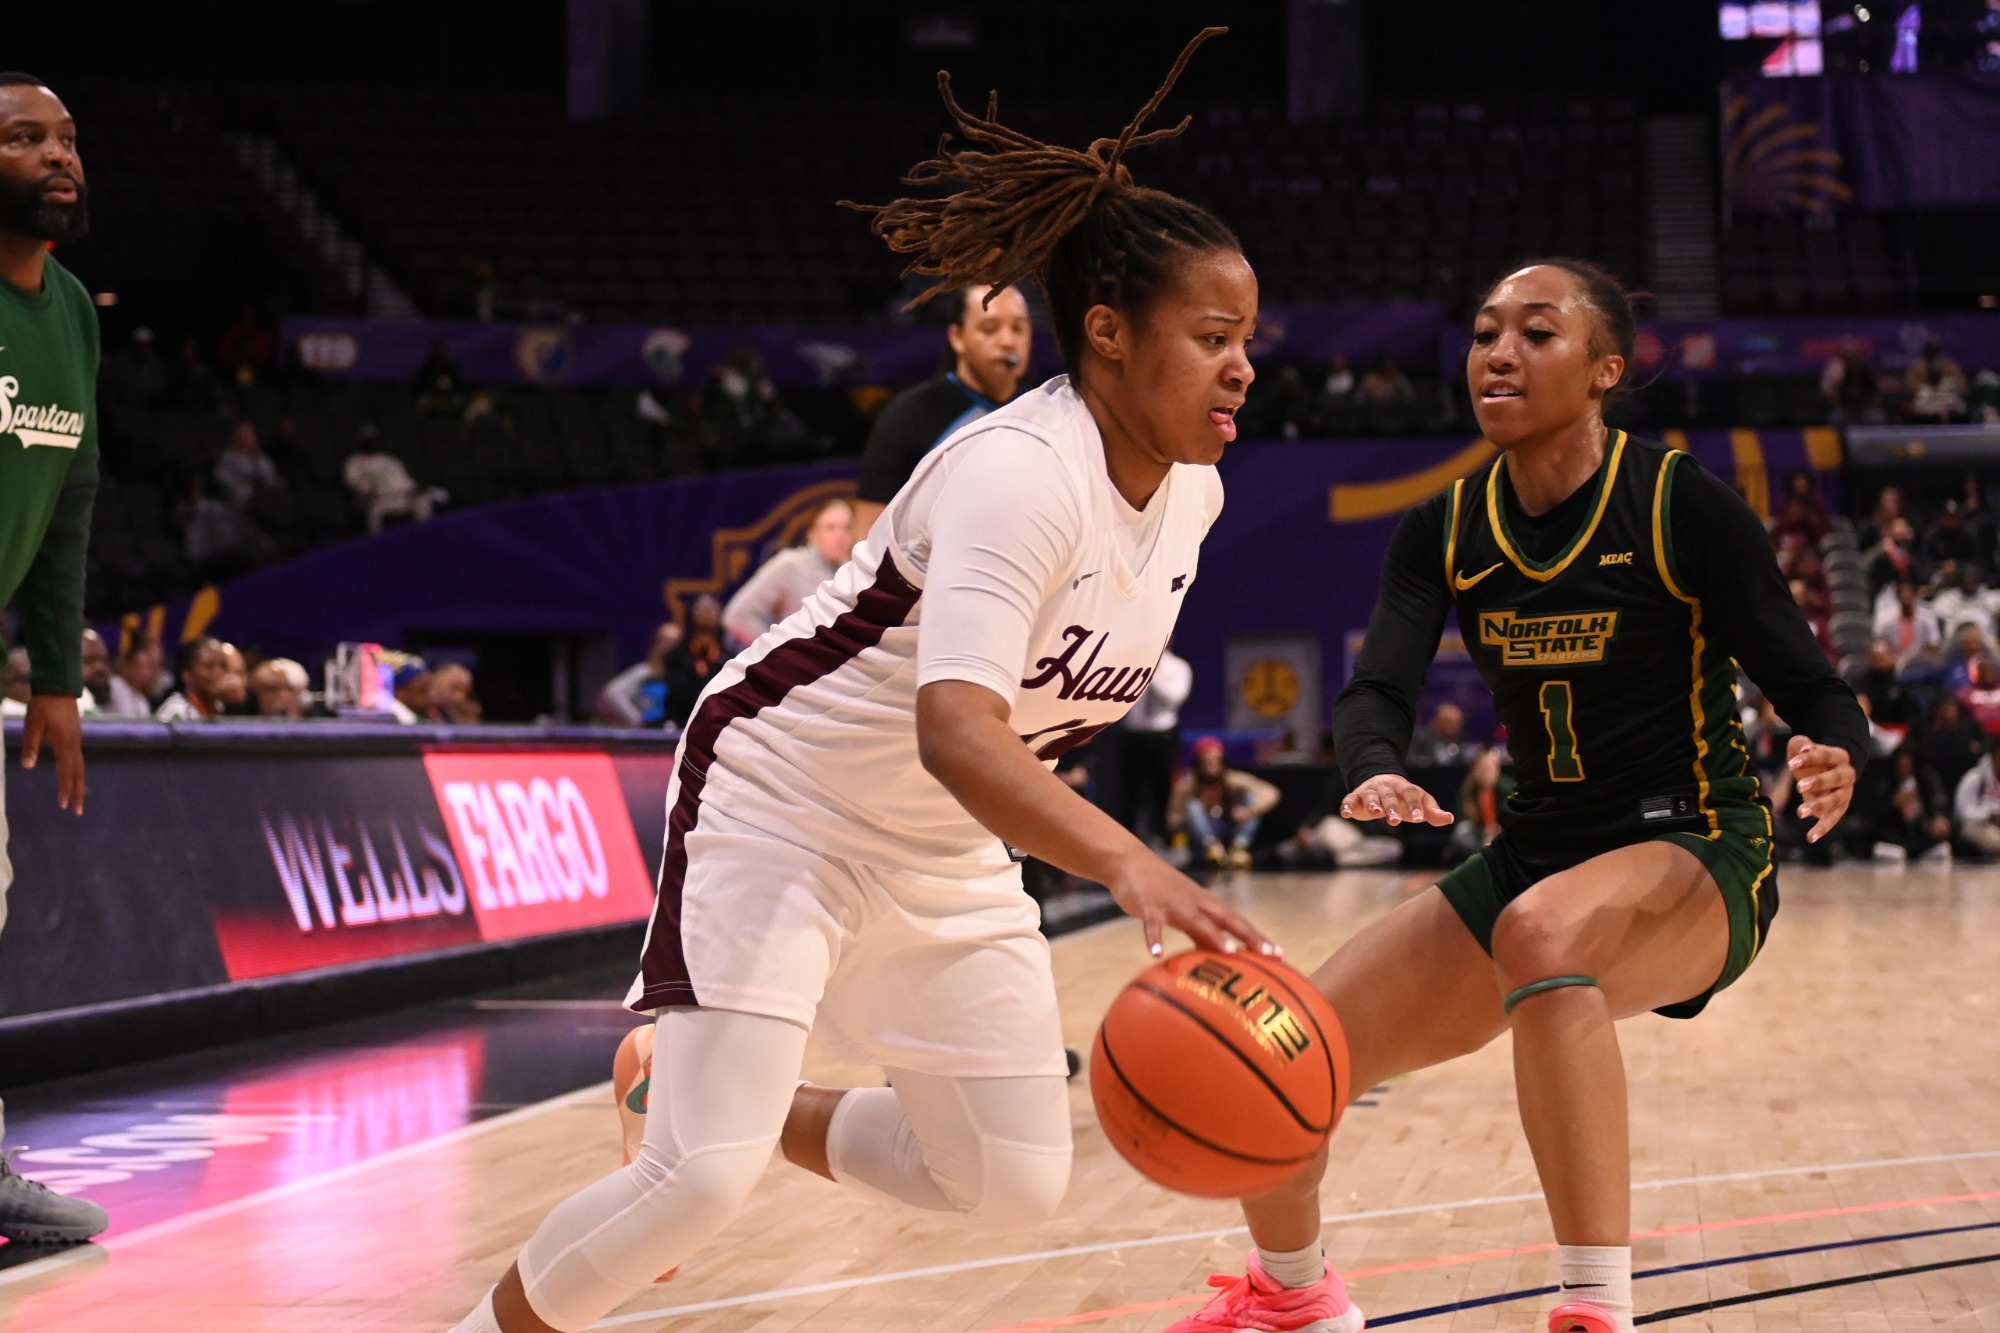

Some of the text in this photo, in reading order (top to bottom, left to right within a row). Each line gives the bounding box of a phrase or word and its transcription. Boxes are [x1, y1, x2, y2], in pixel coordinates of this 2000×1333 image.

[1598, 552, 1634, 567] MEAC
[1484, 616, 1609, 641] NORFOLK
[1507, 634, 1600, 661] STATE
[1535, 650, 1598, 661] SPARTANS
[1539, 681, 1585, 782] 1
[1679, 801, 1687, 811] S
[259, 775, 609, 932] WELLS FARGO
[1187, 958, 1310, 1062] ELITE
